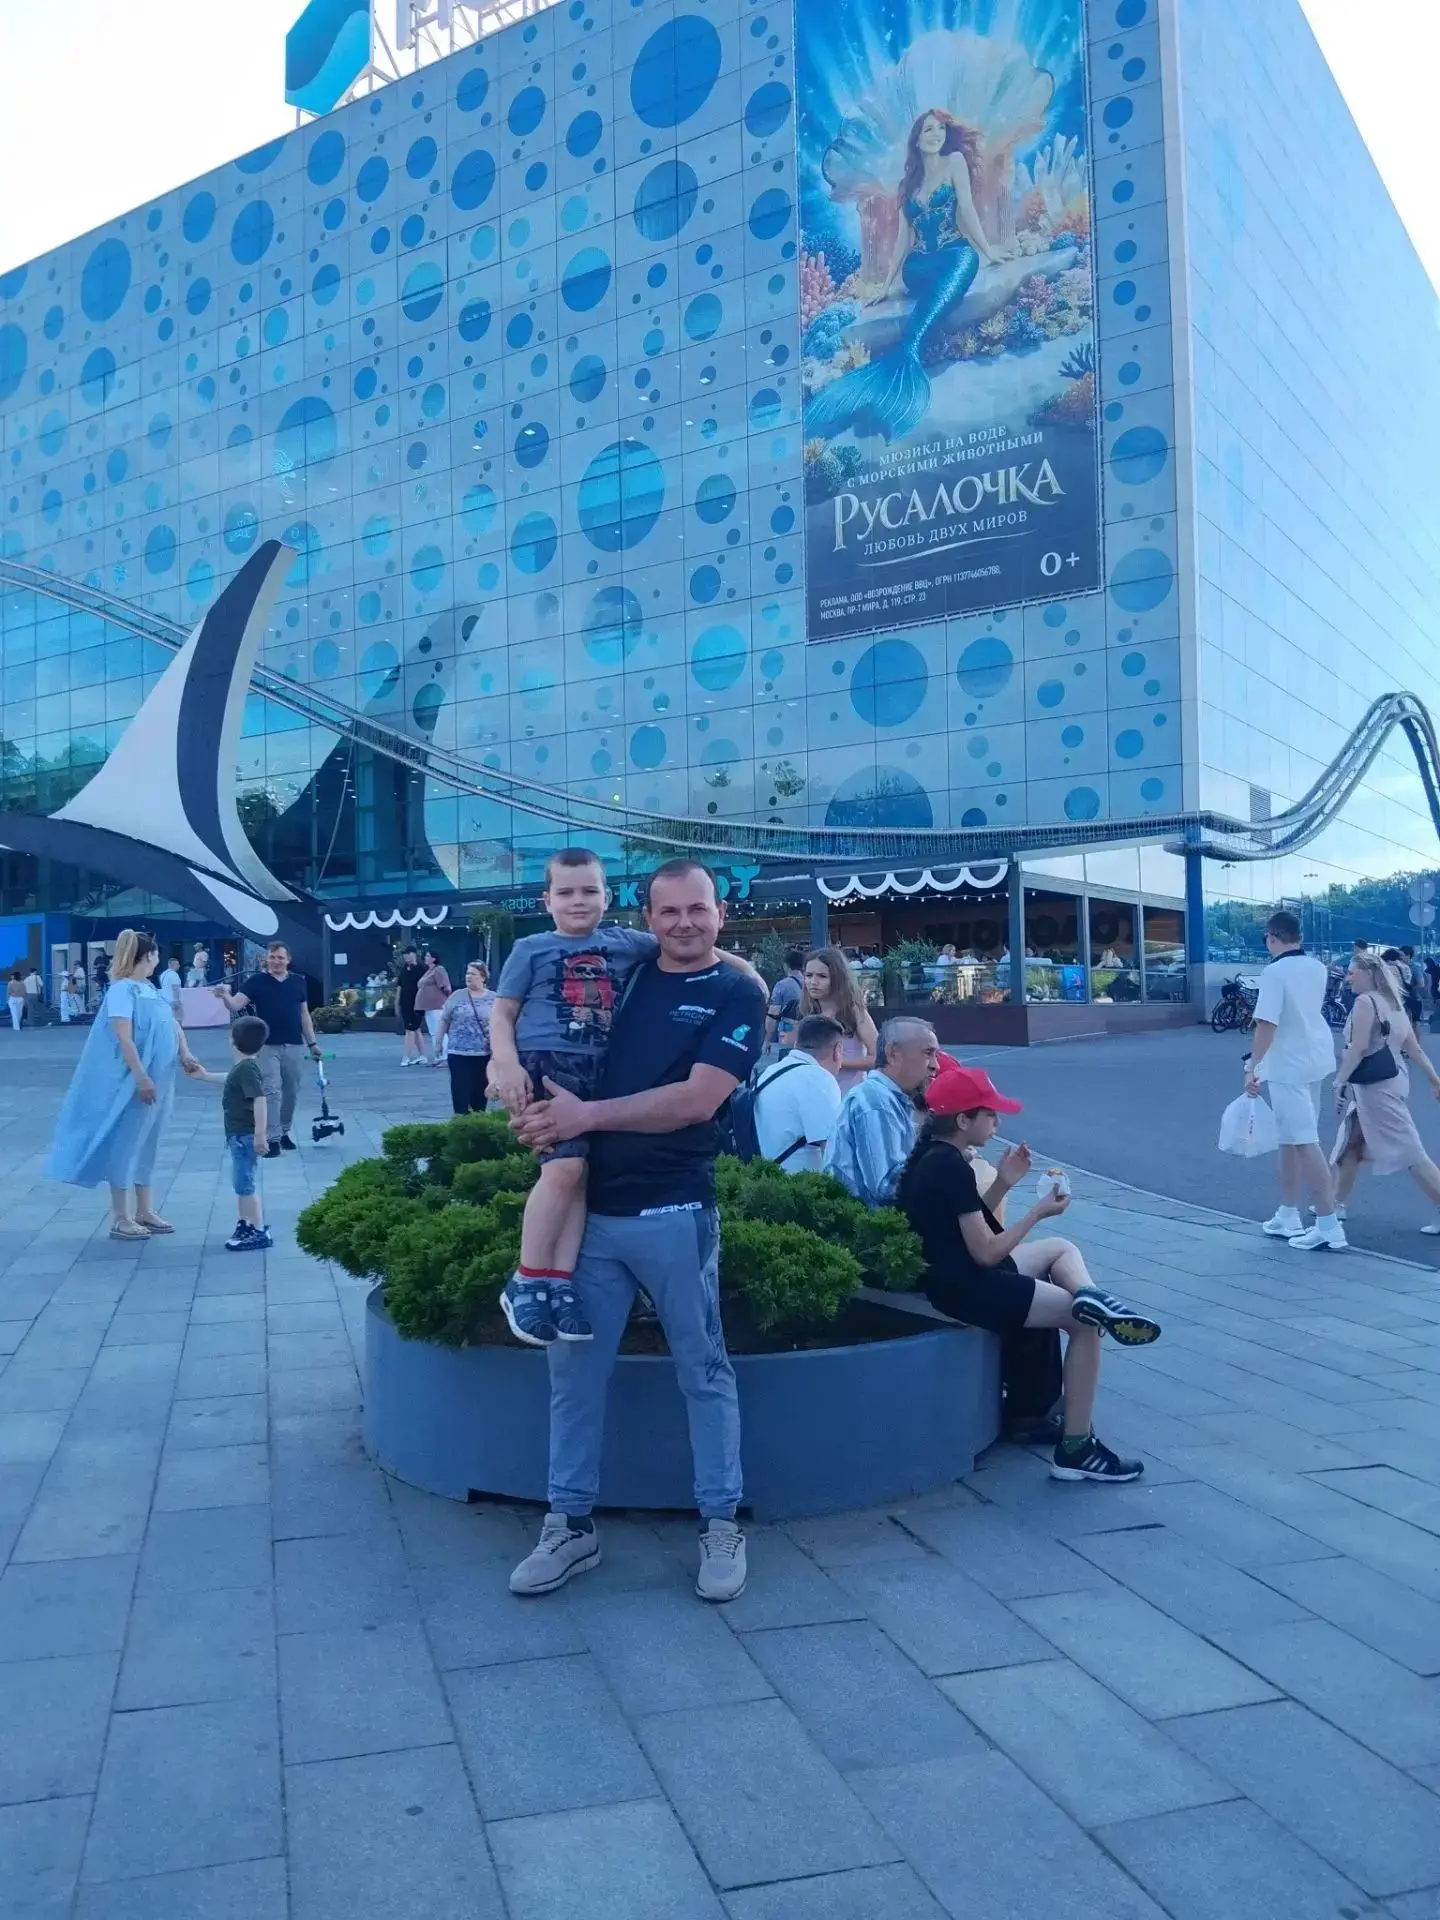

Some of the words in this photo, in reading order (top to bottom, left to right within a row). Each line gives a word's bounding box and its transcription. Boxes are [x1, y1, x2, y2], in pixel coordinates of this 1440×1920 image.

[847, 477, 855, 488] С
[859, 457, 937, 486] МОРСКИМИ
[943, 431, 1043, 466] ЖИВОТНЫМИ
[879, 441, 941, 466] МЮЗИКЛ
[945, 436, 964, 450] НА
[968, 425, 1007, 445] ВОДЕ
[832, 458, 1067, 553] РУСАЛОЧКА
[864, 532, 925, 556] ЛЮБОВЬ
[929, 522, 968, 543] ДВУХ
[973, 510, 1028, 533] МИРОВ
[1040, 551, 1081, 576] 0+
[919, 592, 926, 602] 23
[500, 896, 536, 912] кафе
